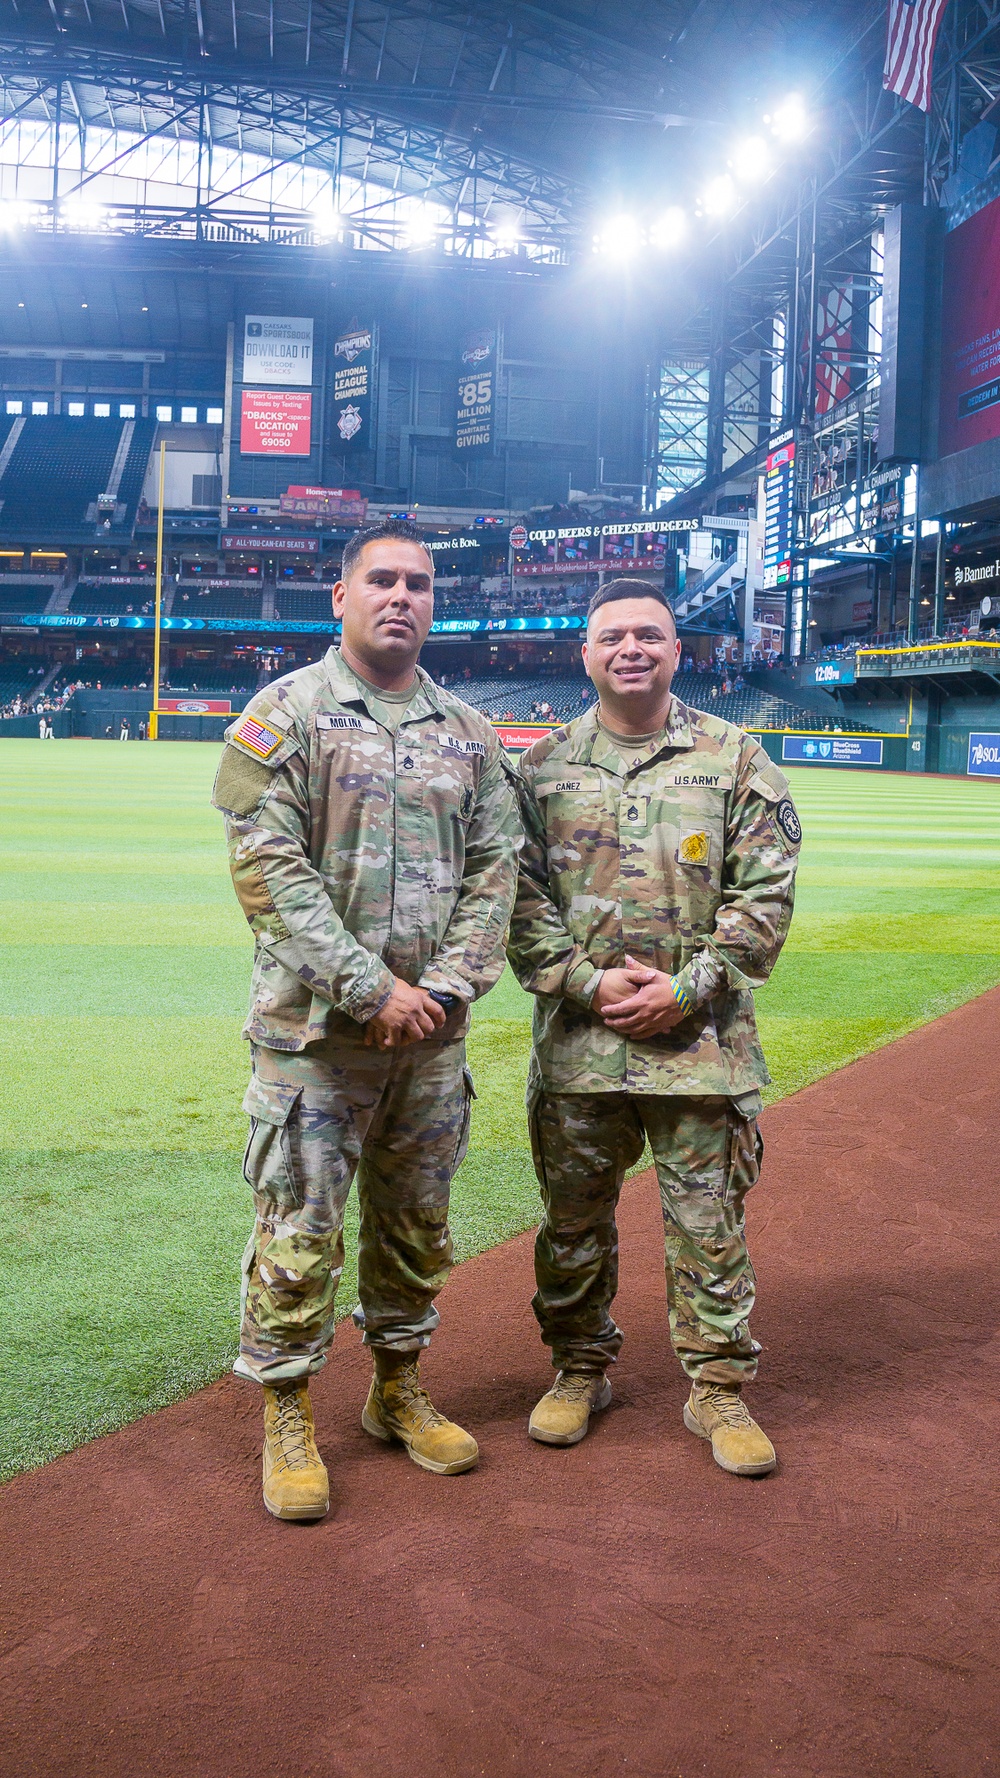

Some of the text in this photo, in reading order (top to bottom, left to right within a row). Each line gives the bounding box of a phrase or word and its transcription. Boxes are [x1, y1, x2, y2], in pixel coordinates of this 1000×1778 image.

[263, 329, 311, 340] SPORTSBOOK
[334, 334, 371, 355] CHAMPIONS
[246, 343, 311, 359] DOWNLOAD IT
[335, 365, 368, 379] NATIONAL
[459, 371, 492, 384] CELEBRATING
[334, 374, 368, 390] LEAGUE
[246, 392, 266, 400] Report
[334, 386, 367, 401] CHAMPIONS
[458, 380, 492, 406] $85
[281, 401, 302, 409] Texting
[457, 405, 491, 419] MILLION
[254, 421, 299, 431] LOCATION
[456, 424, 491, 436] CHARITABLE
[261, 438, 291, 447] 69050
[456, 433, 490, 448] GIVING
[863, 467, 902, 492] NL CHAMPIONS
[305, 488, 343, 497] Honeywell
[528, 529, 556, 541] COLD
[557, 526, 592, 539] BEERS
[593, 526, 600, 537] &
[601, 518, 699, 536] CHEESEBURGERS
[236, 539, 305, 549] ALL-YOU-CAN-EAT SEATS
[451, 538, 459, 549] &
[541, 560, 622, 573] Your Neighborhood Burger Joint
[964, 565, 994, 583] Banner
[40, 616, 87, 625] MATCHUP
[442, 620, 480, 632] MATCHUP
[329, 717, 364, 729] MOLINA
[833, 741, 860, 749] BlueCross
[833, 747, 862, 755] BlueShield
[555, 780, 581, 791] CAÑEZ
